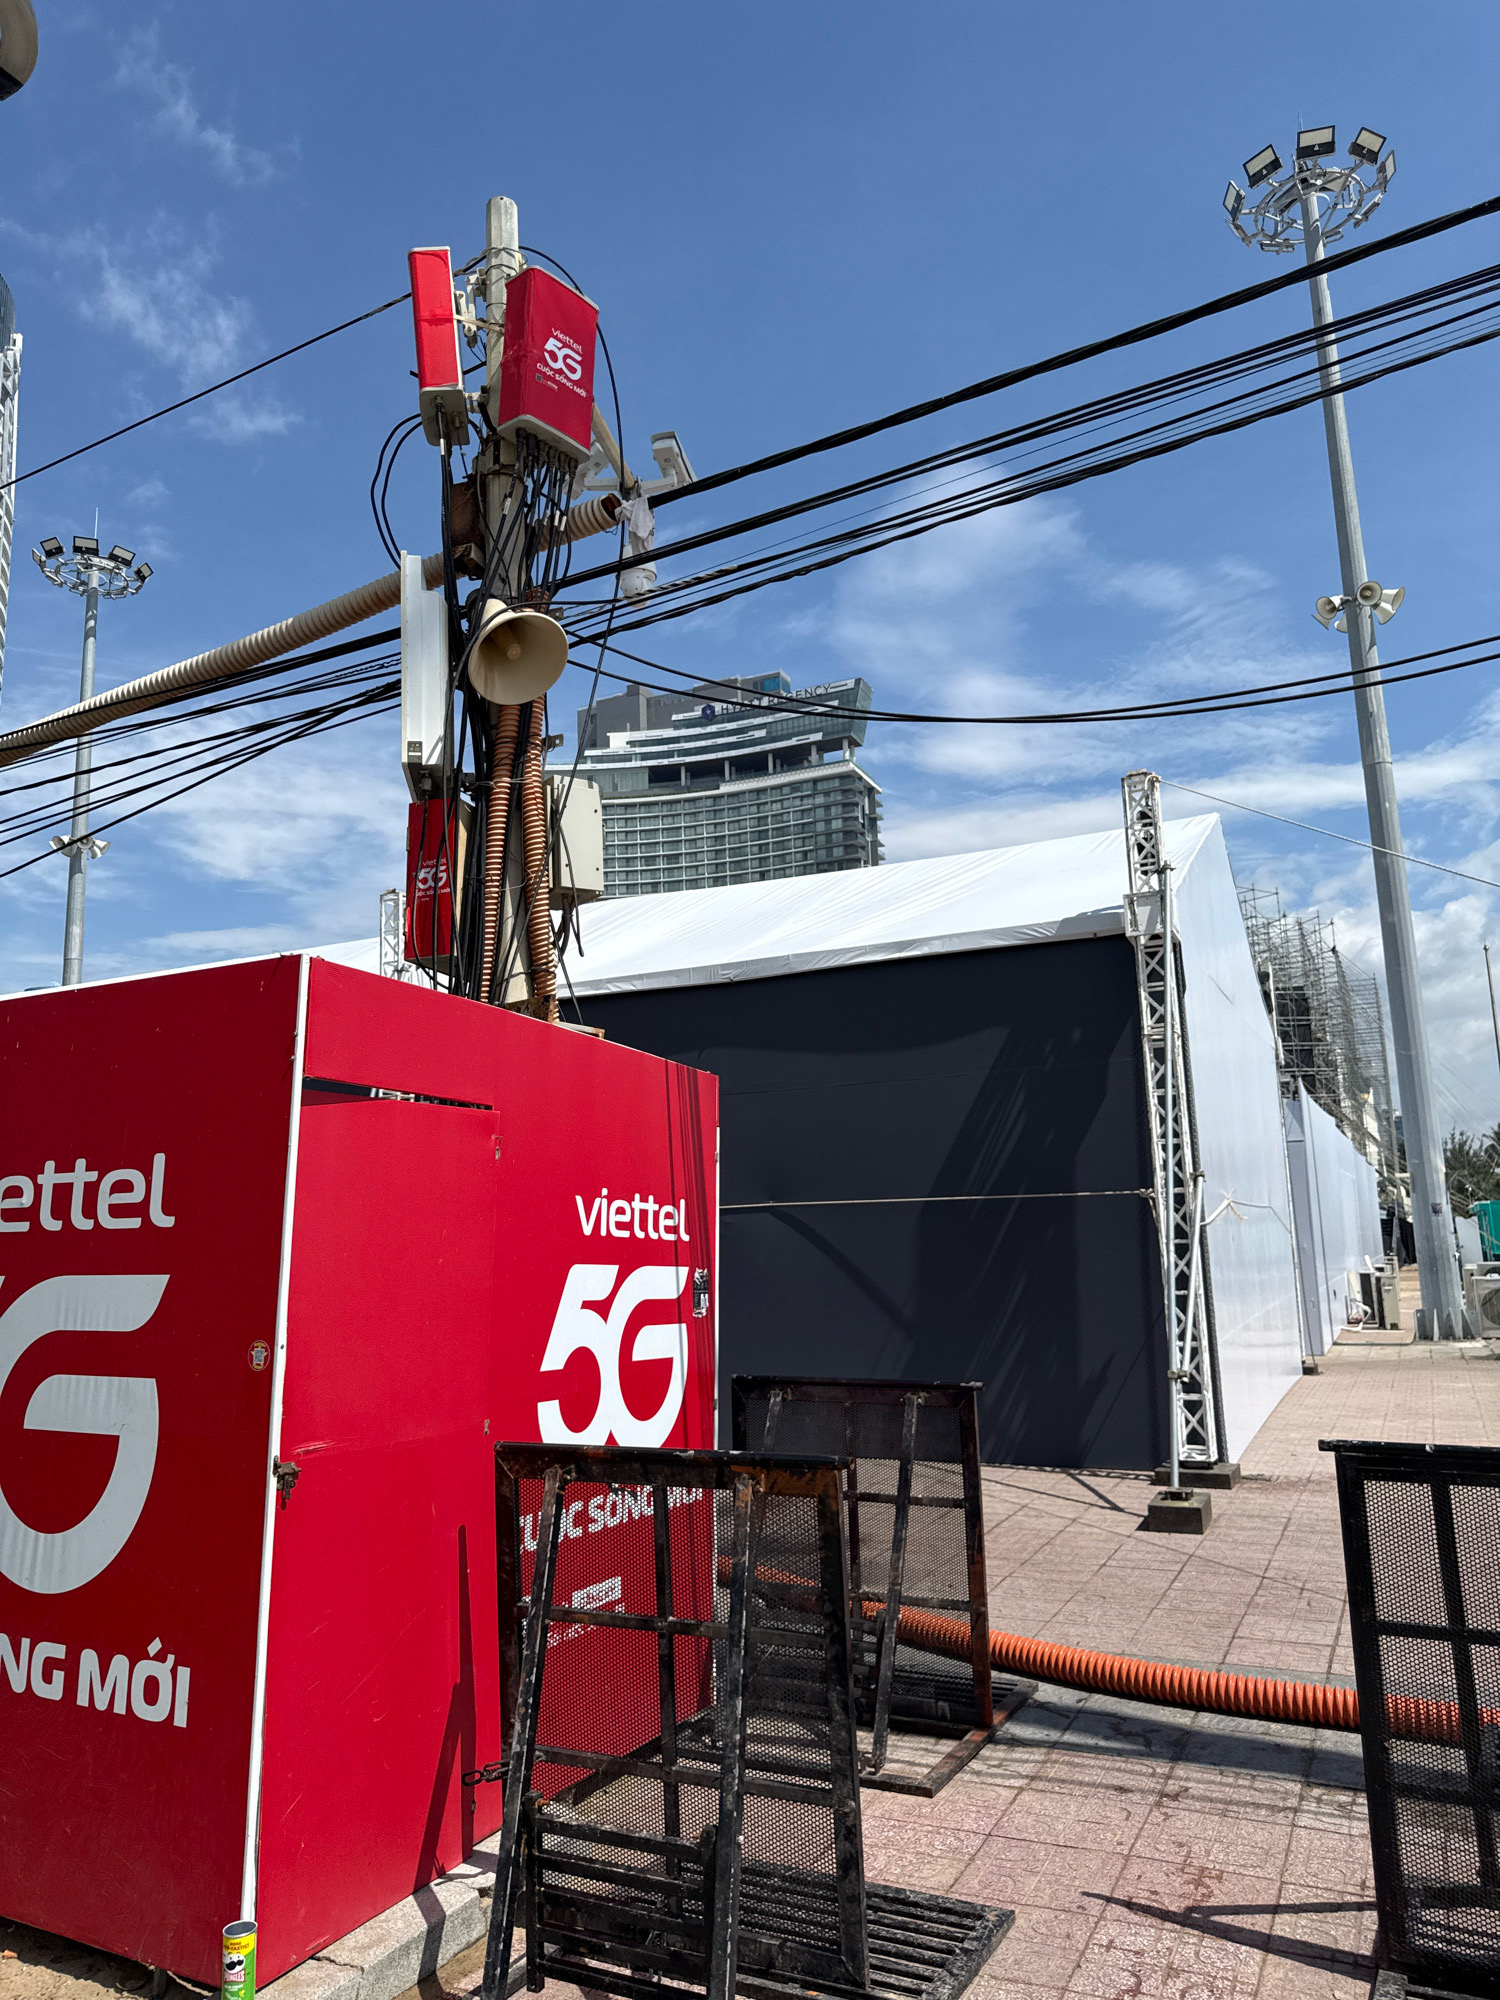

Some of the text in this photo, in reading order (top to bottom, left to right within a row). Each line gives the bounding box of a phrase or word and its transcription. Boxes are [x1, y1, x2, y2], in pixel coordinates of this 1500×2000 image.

[544, 337, 582, 380] 5G
[552, 328, 583, 354] viettel
[575, 1187, 690, 1242] viettel
[538, 1264, 689, 1449] 5G
[0, 1274, 170, 1594] G
[76, 1637, 191, 1728] MỚI
